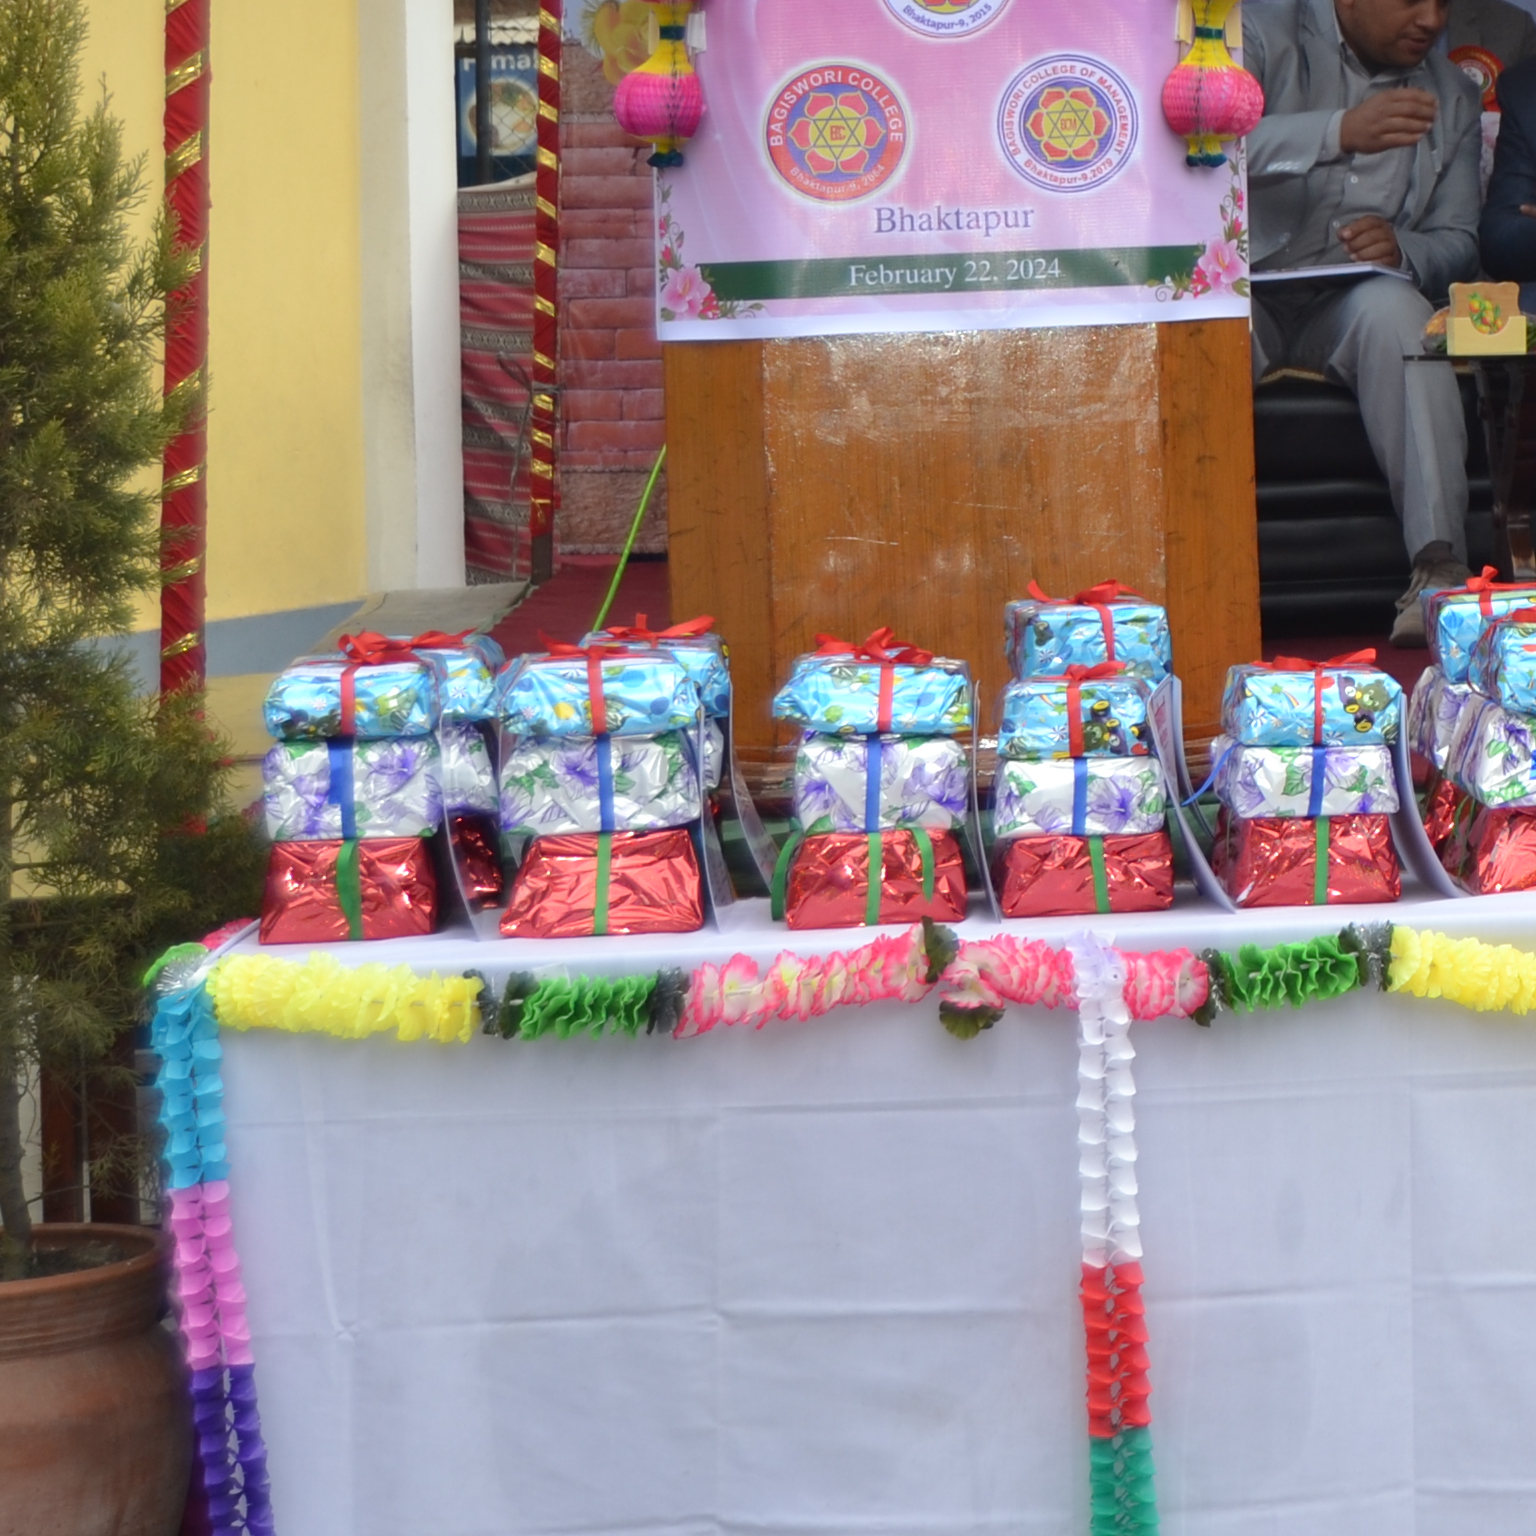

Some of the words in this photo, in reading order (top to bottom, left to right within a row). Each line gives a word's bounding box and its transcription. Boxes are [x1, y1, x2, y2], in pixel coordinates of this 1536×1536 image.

[969, 2, 993, 24] 2015
[770, 70, 843, 147] BAGISWORI
[848, 72, 904, 142] COLLEGE
[1004, 89, 1026, 157] BAGISWORI
[1022, 64, 1077, 90] COLLEGE
[1080, 67, 1096, 79] OF
[1096, 76, 1129, 155] MANAGEMENT
[873, 204, 1035, 238] Bhaktapur
[849, 264, 957, 288] February
[1006, 257, 1062, 281] 2024
